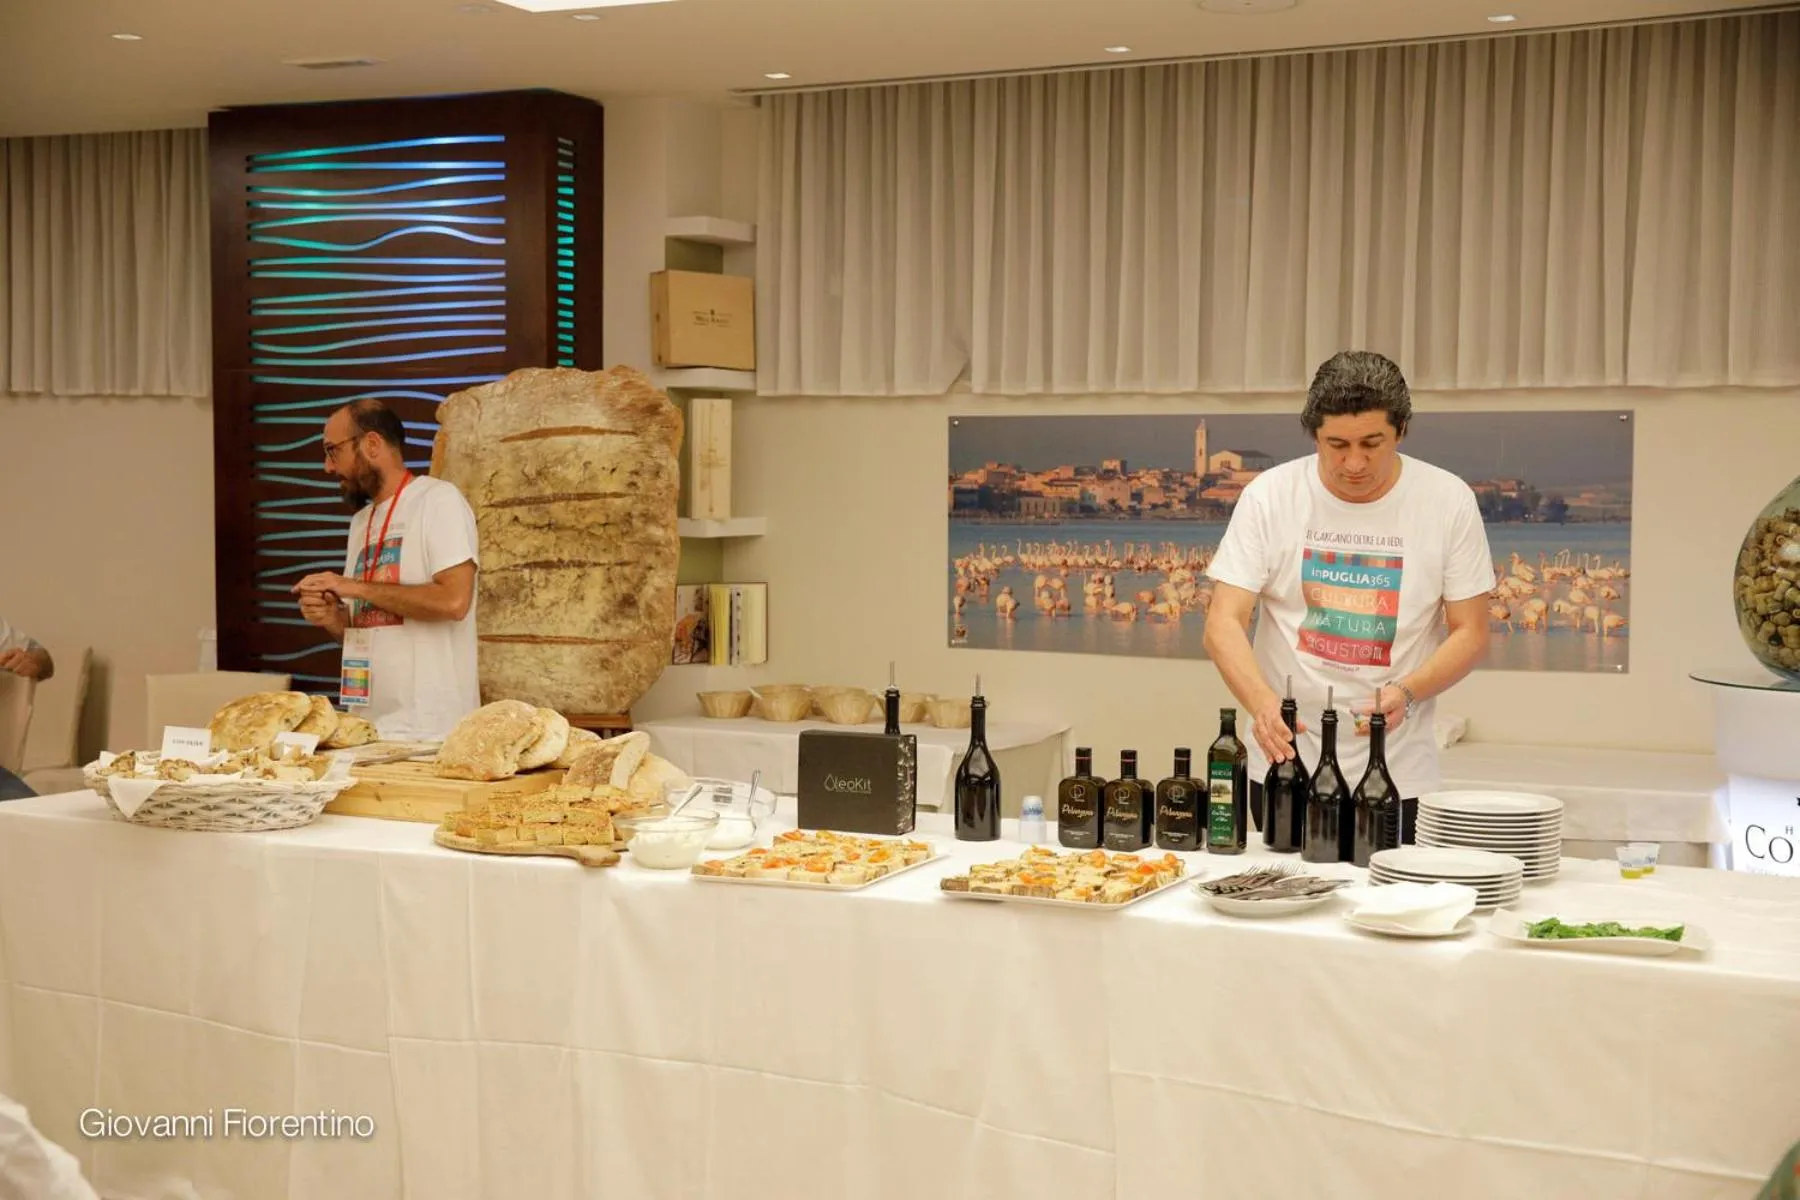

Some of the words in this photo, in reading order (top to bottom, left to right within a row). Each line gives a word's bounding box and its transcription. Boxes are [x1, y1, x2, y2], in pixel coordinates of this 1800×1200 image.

[1311, 566, 1391, 588] inPUGLIA365
[1310, 586, 1390, 611] CULTURA
[1311, 611, 1386, 635] NATURA
